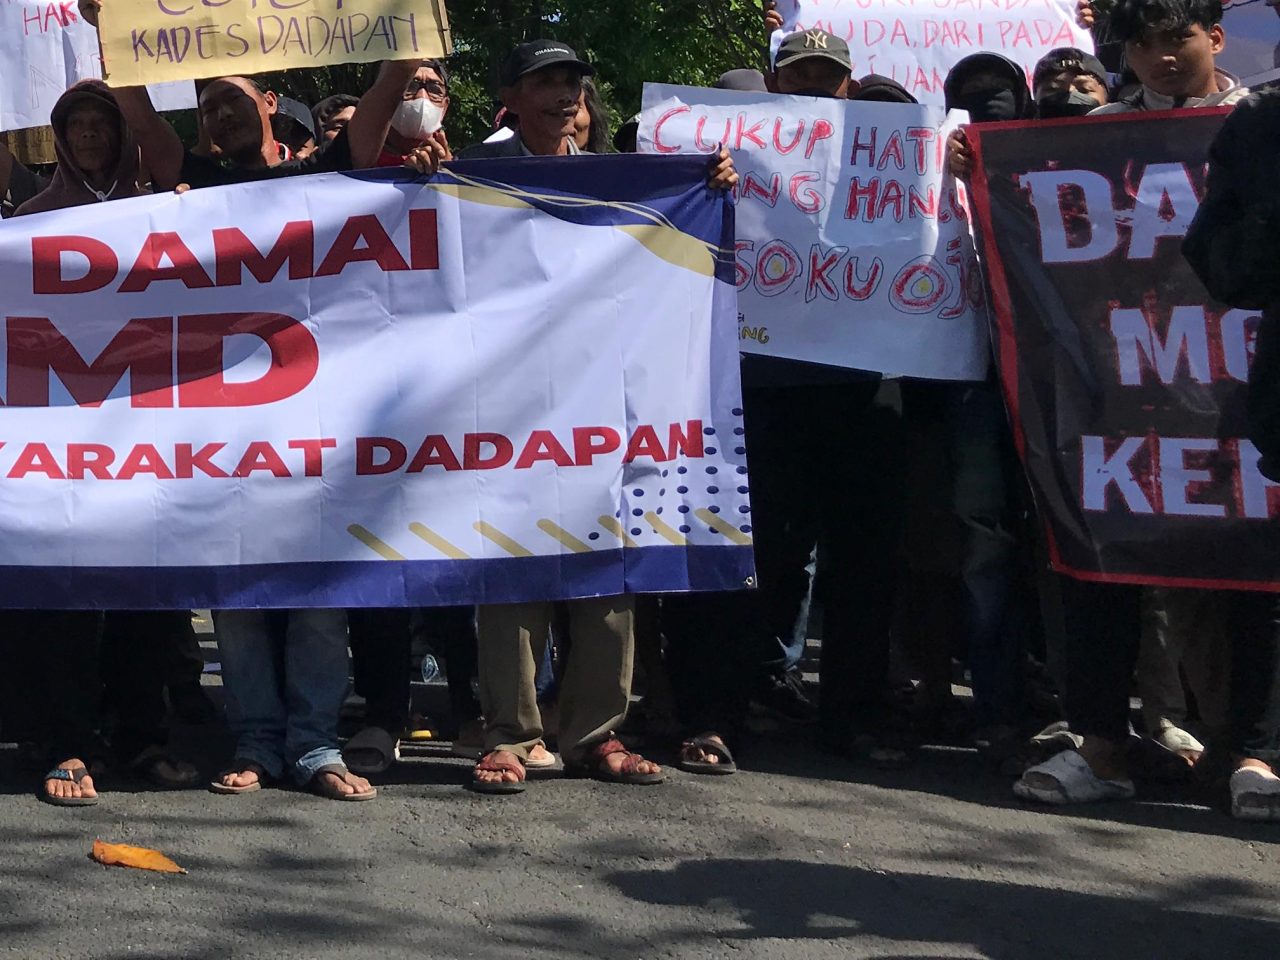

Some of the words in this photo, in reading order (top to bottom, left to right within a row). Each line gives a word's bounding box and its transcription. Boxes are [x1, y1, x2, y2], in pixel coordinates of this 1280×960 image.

[23, 1, 77, 35] HAK
[131, 22, 249, 64] KADES
[257, 12, 419, 60] DADAPAN
[804, 31, 827, 49] NY
[923, 19, 984, 49] DARI
[999, 19, 1077, 49] PADA
[652, 104, 835, 159] CUKUP
[32, 209, 440, 295] DAMAI
[356, 419, 705, 476] DADAPAN
